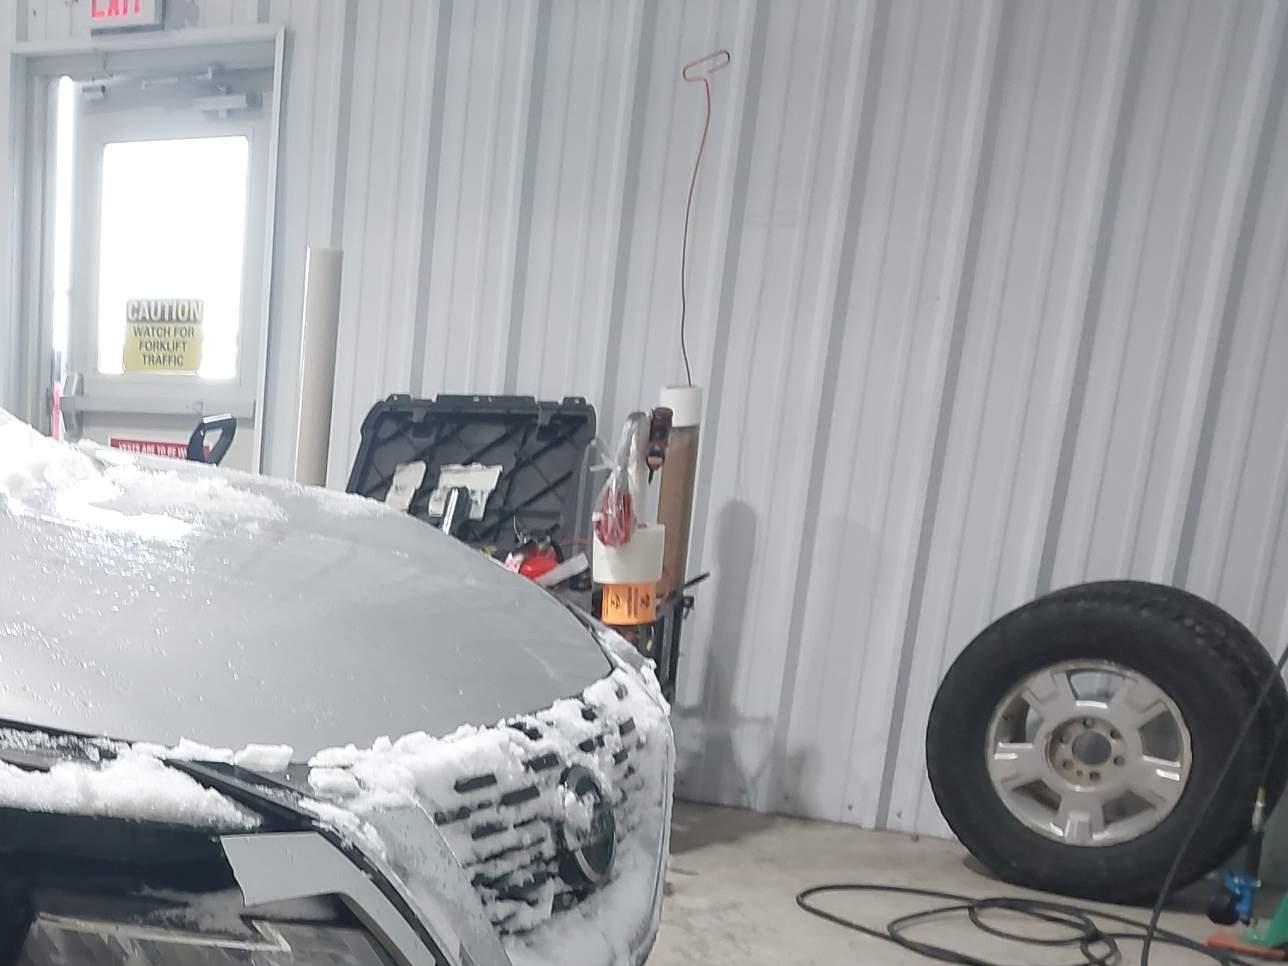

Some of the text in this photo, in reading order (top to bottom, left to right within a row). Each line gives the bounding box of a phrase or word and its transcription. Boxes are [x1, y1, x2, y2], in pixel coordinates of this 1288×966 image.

[127, 300, 203, 321] CAUTION
[133, 325, 195, 338] WATCH FOR
[139, 340, 187, 353] FORKLIFT
[143, 354, 184, 367] TRAFFIC
